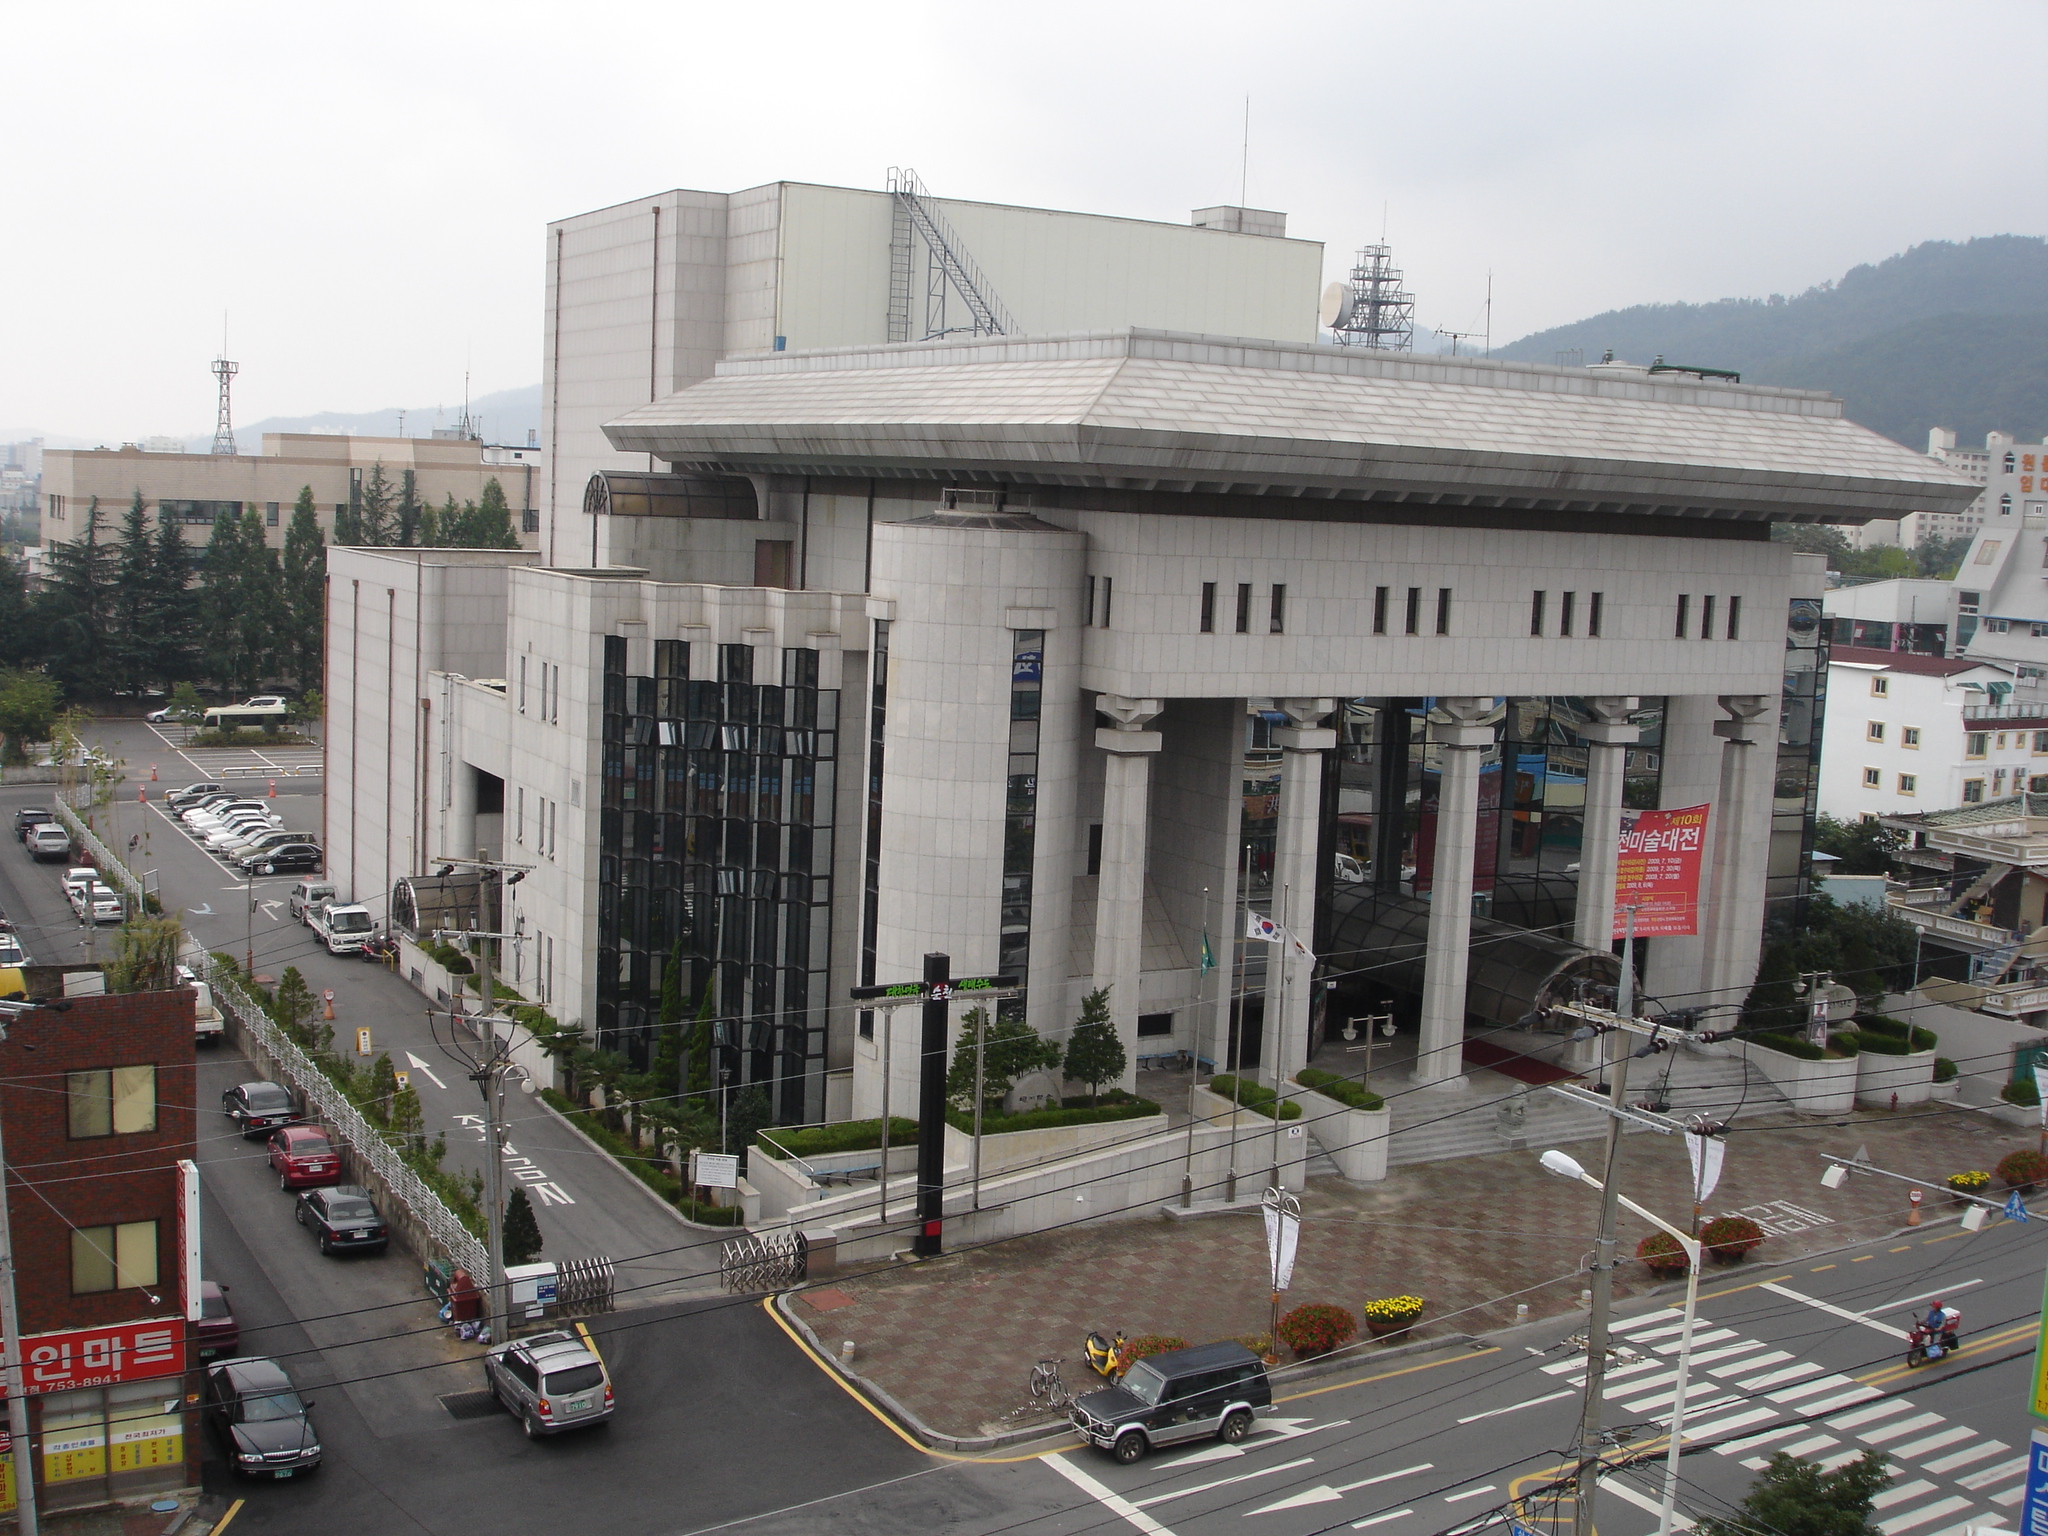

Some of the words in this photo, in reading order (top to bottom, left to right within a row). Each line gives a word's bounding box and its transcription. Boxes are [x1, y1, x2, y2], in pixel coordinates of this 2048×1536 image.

[1670, 813, 1703, 826] 제10회
[0, 1329, 174, 1387] 인마트
[46, 1373, 122, 1392] 753-8941
